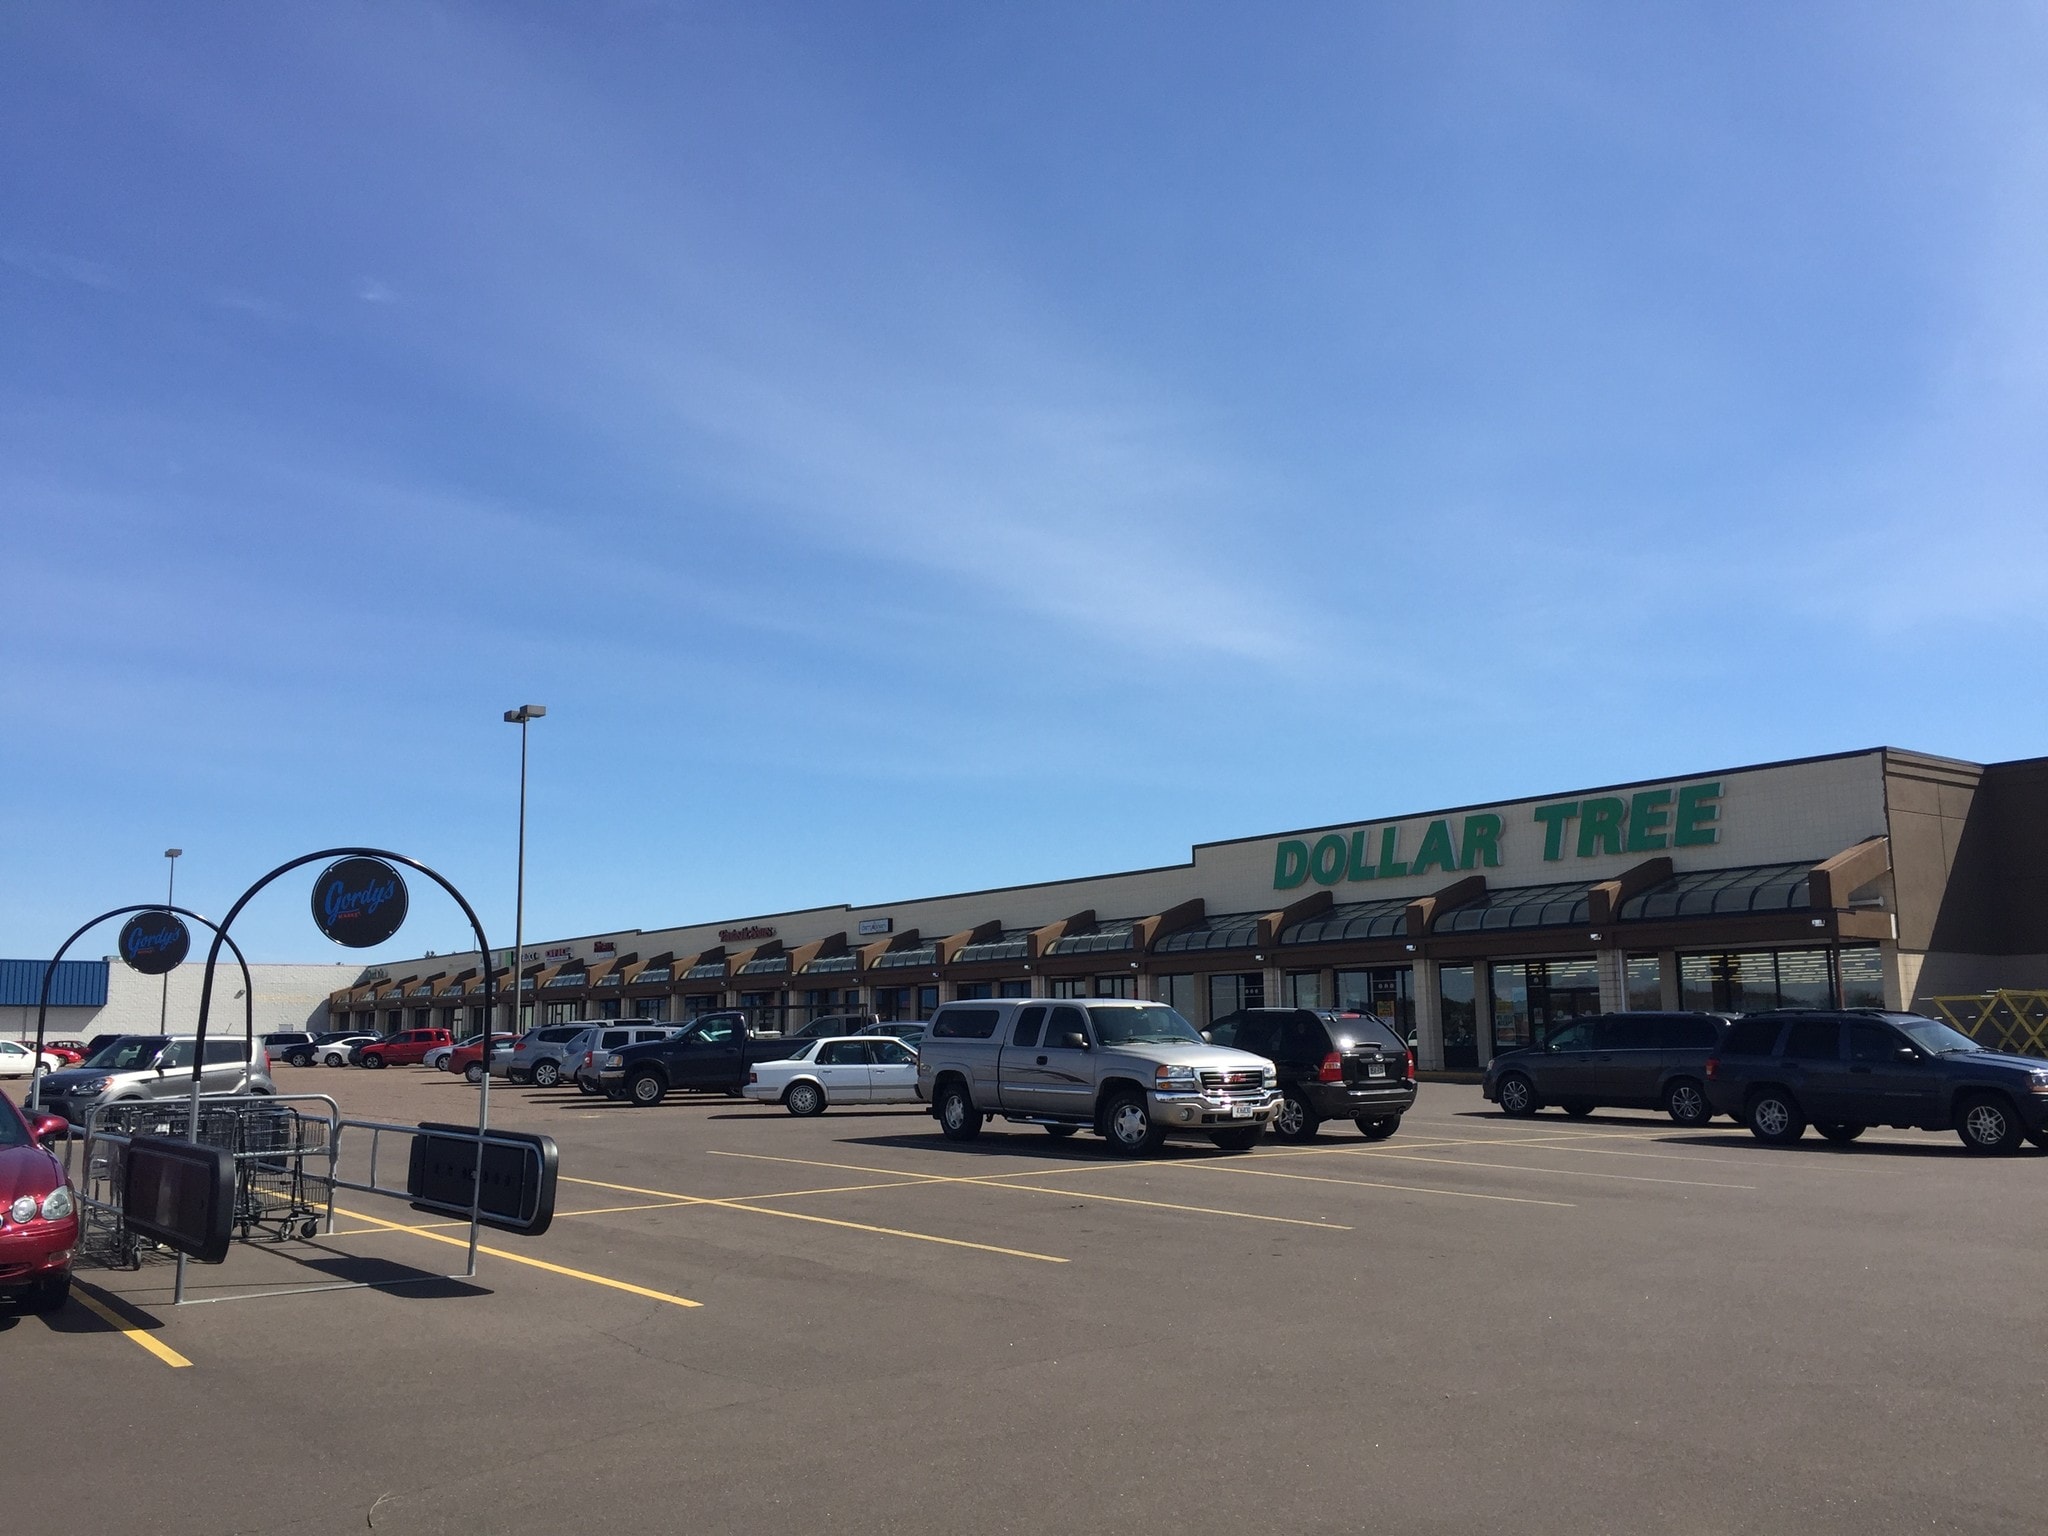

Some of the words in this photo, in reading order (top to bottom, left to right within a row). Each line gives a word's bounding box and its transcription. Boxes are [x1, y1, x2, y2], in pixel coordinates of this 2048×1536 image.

[1273, 813, 1504, 890] DOLLAR
[1534, 782, 1725, 862] TREE
[324, 879, 396, 927] Gordy's
[128, 926, 182, 960] Gordy's
